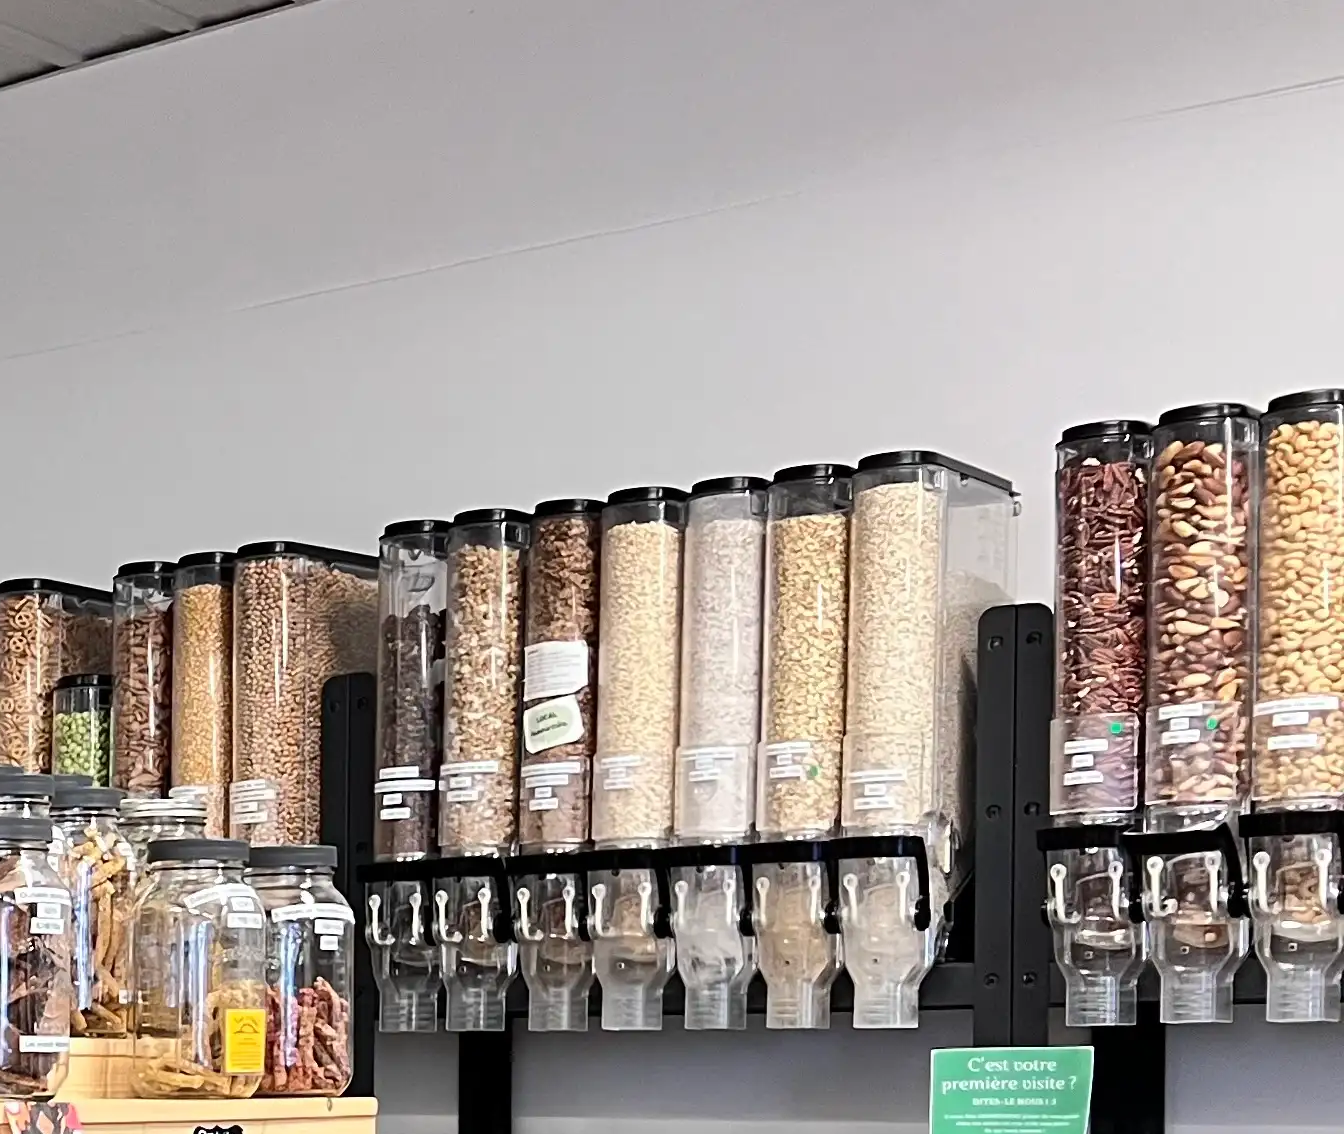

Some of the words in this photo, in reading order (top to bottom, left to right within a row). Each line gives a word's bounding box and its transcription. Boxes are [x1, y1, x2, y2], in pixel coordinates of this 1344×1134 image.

[967, 1056, 1009, 1073] C'est
[1013, 1058, 1057, 1072] votre
[941, 1075, 1018, 1095] première
[1022, 1075, 1065, 1090] visite
